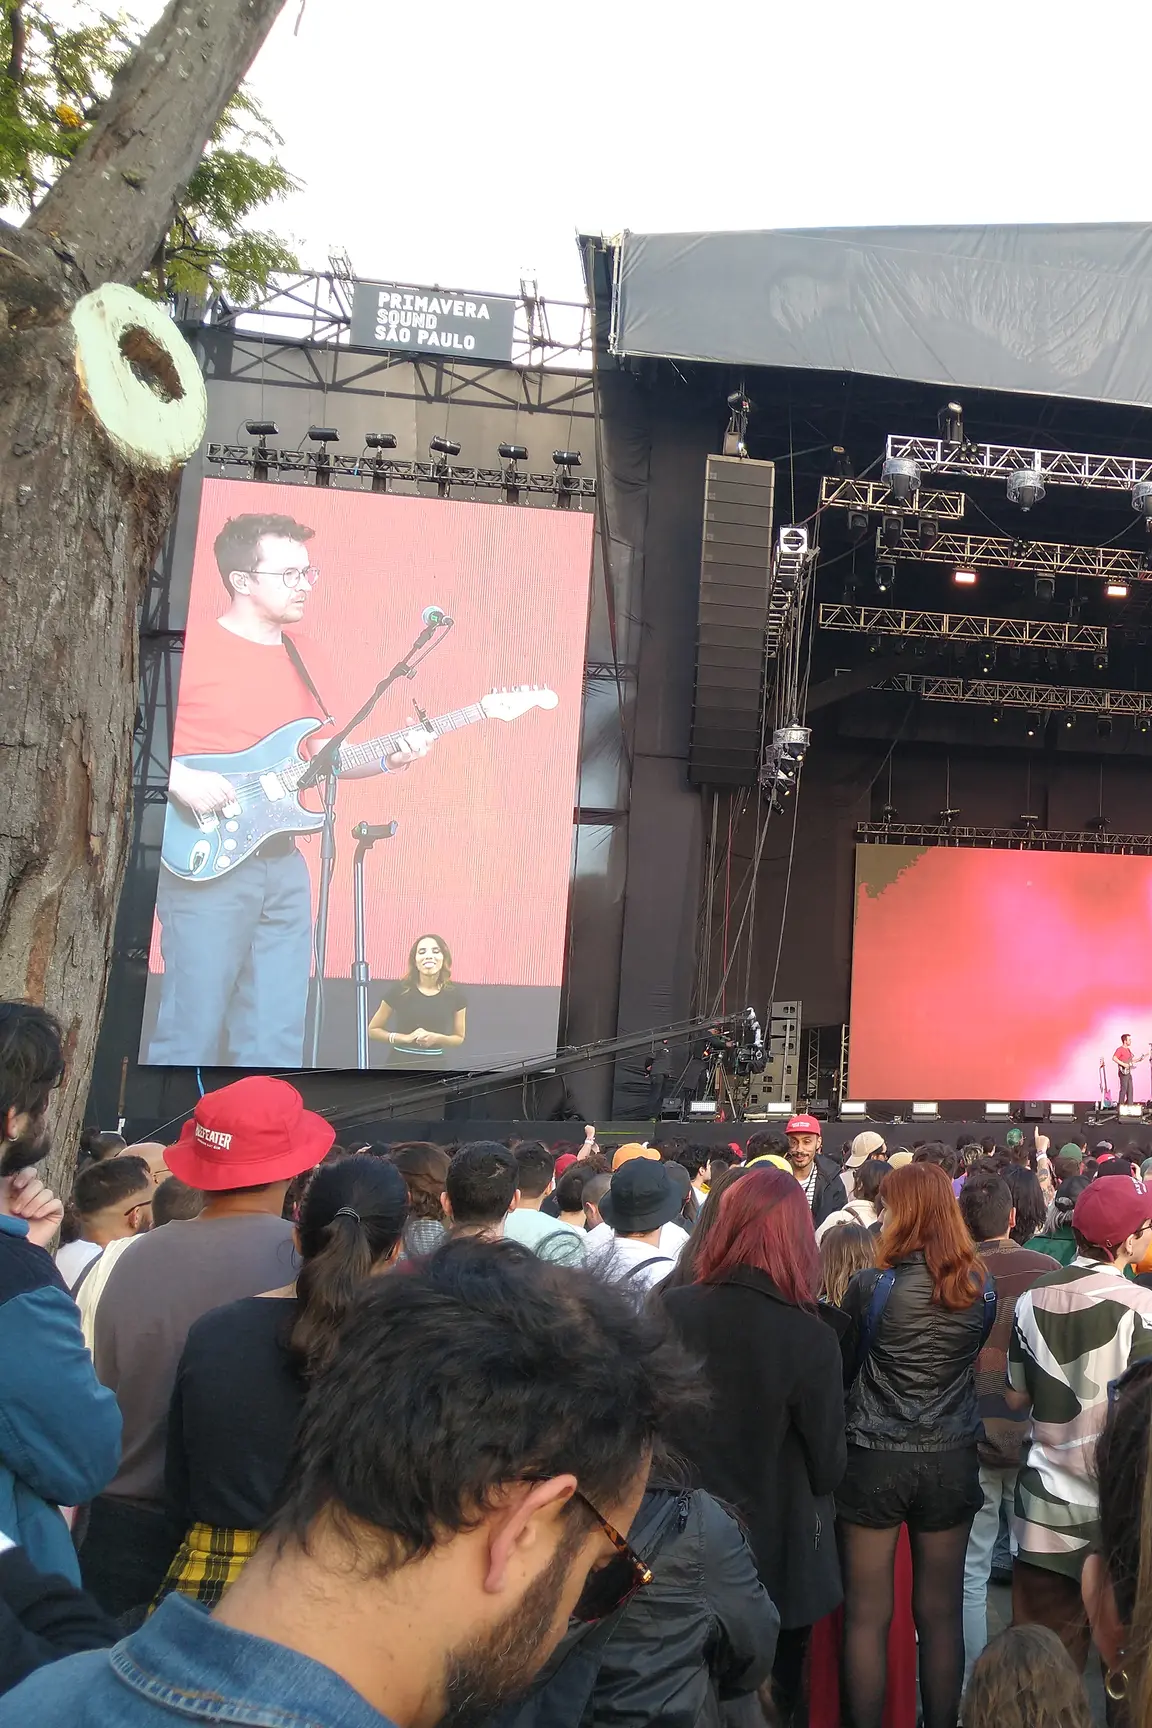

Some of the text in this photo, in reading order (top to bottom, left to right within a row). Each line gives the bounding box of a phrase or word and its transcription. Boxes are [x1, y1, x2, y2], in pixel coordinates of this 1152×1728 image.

[376, 308, 438, 329] SOUND
[378, 292, 490, 319] PRIMAVERA
[374, 324, 476, 350] SÃO PAULO
